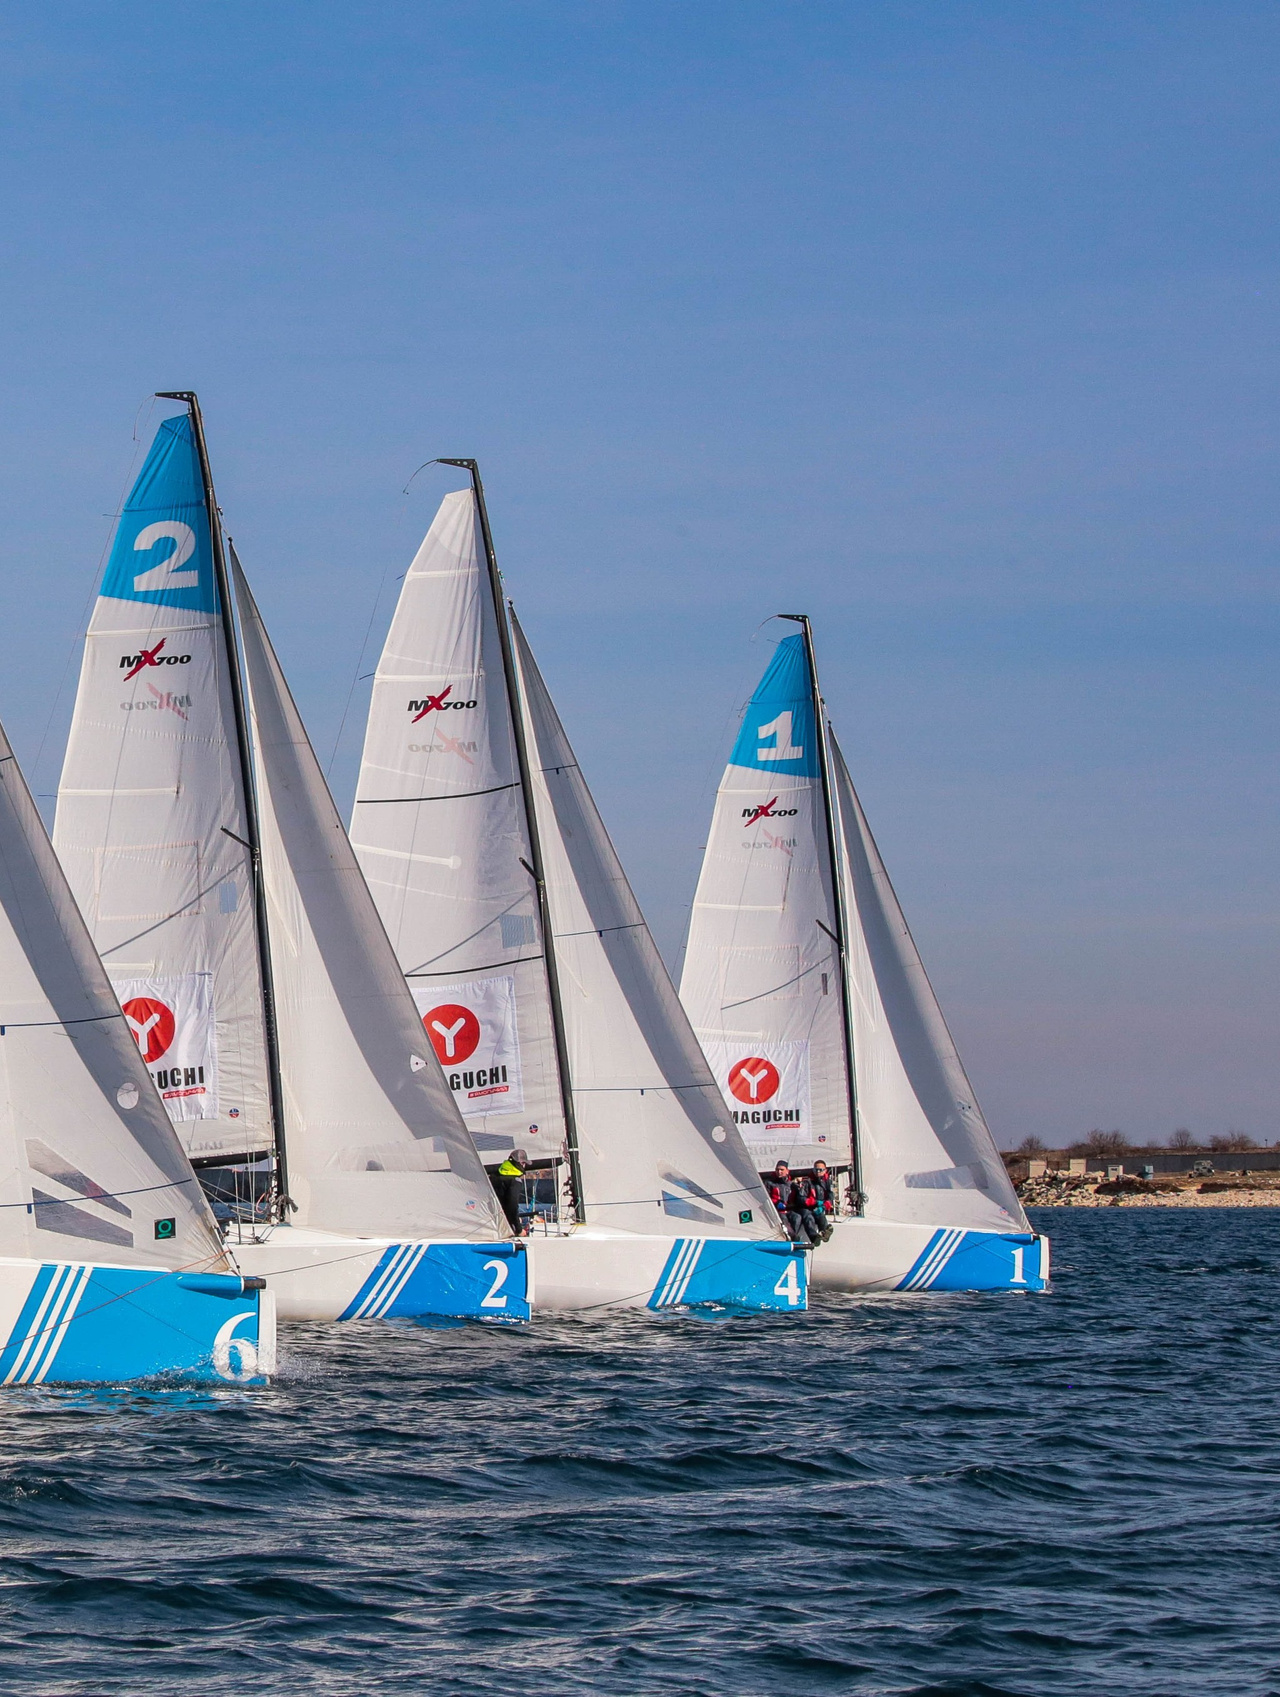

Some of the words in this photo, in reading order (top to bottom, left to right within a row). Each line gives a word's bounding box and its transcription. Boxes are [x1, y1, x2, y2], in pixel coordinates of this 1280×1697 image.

[133, 520, 199, 592] 2
[119, 637, 192, 682] MX700
[407, 684, 477, 724] MX700
[757, 710, 803, 761] 1
[741, 796, 798, 828] MX700
[431, 1017, 466, 1058] Y
[151, 1066, 205, 1090] UCHI
[449, 1065, 508, 1091] GUCHI
[740, 1068, 768, 1099] Y
[480, 1259, 509, 1308] 2
[774, 1260, 801, 1306] 4
[1009, 1247, 1028, 1283] 1
[213, 1312, 258, 1382] 6
